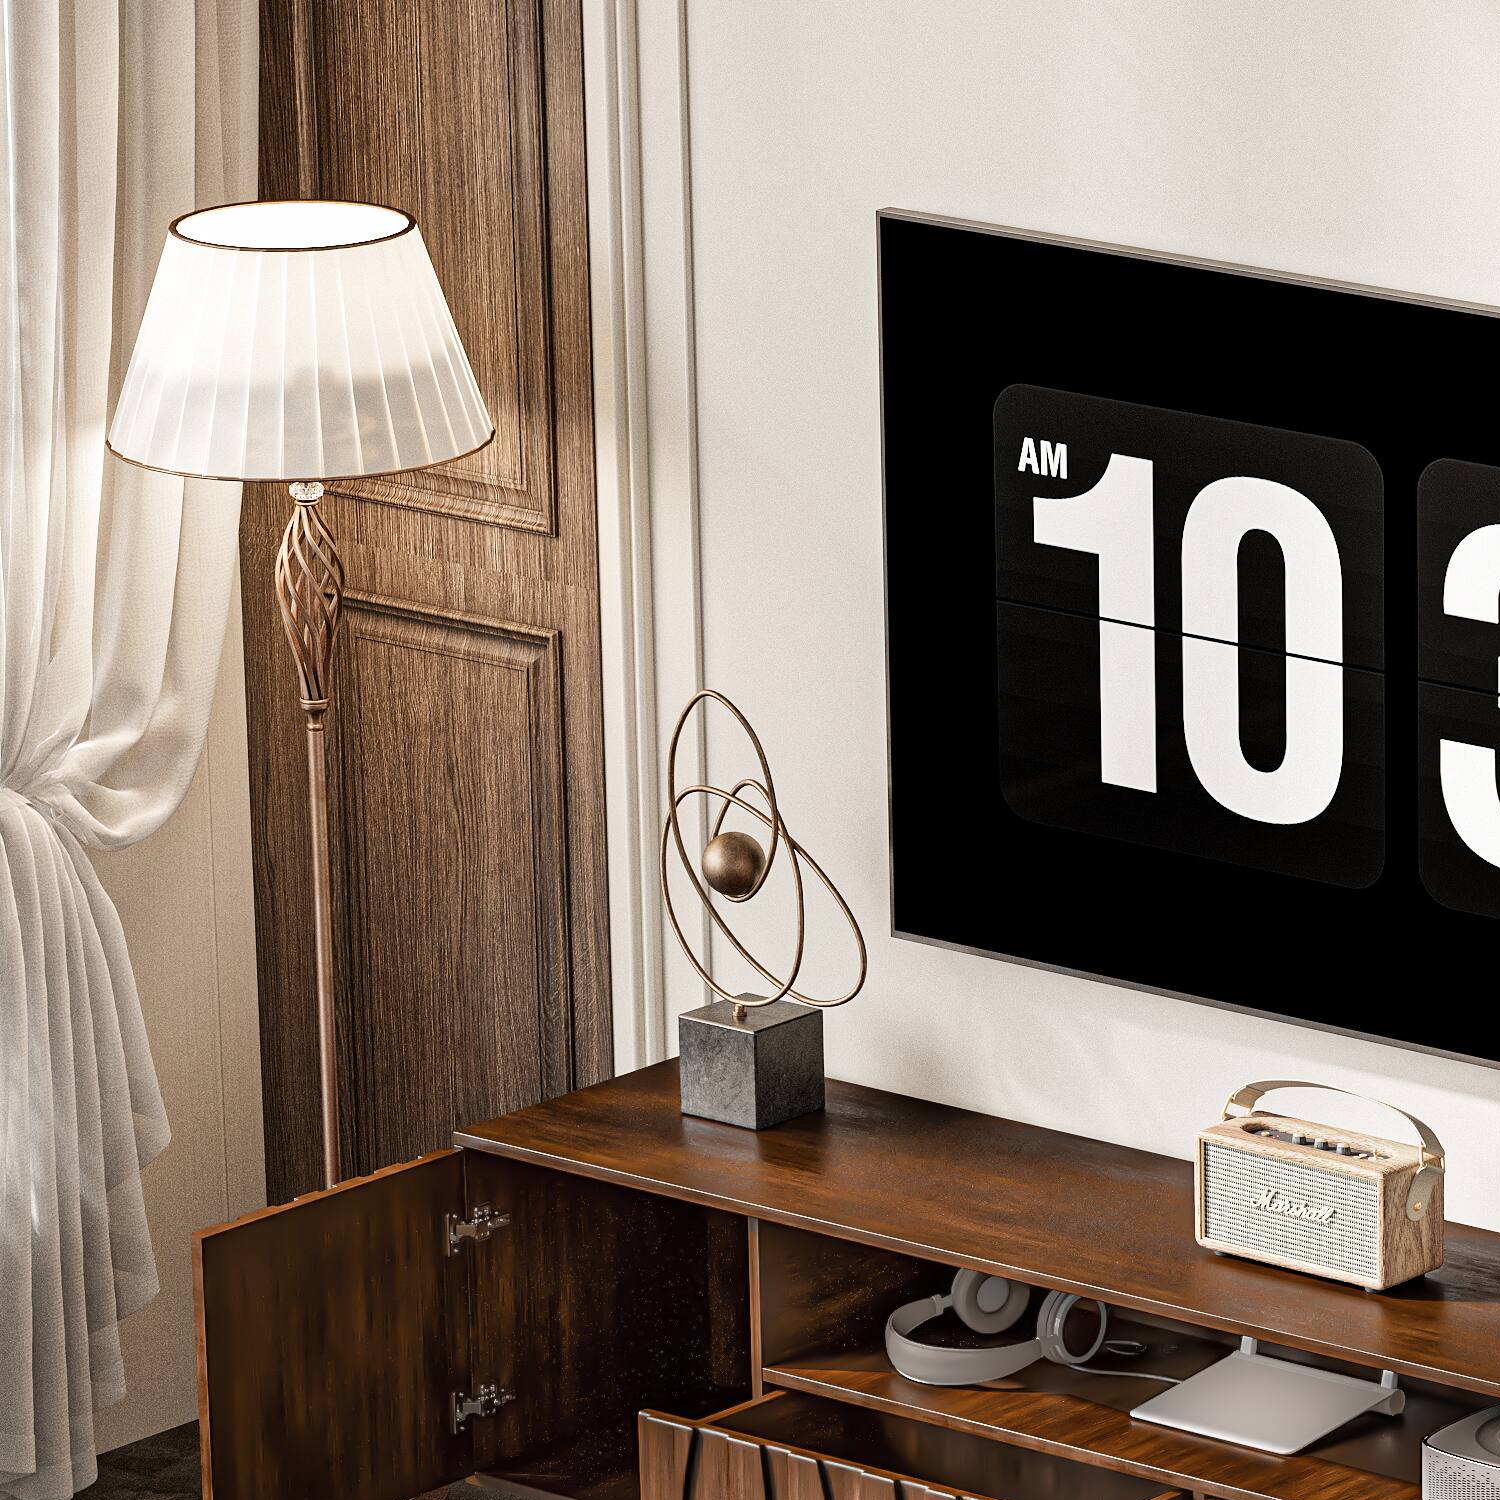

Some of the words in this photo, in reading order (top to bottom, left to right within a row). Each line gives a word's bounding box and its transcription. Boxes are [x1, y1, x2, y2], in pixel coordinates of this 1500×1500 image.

[1018, 437, 1067, 479] AM
[1033, 453, 1343, 825] 10
[1251, 1188, 1336, 1227] Marshall
